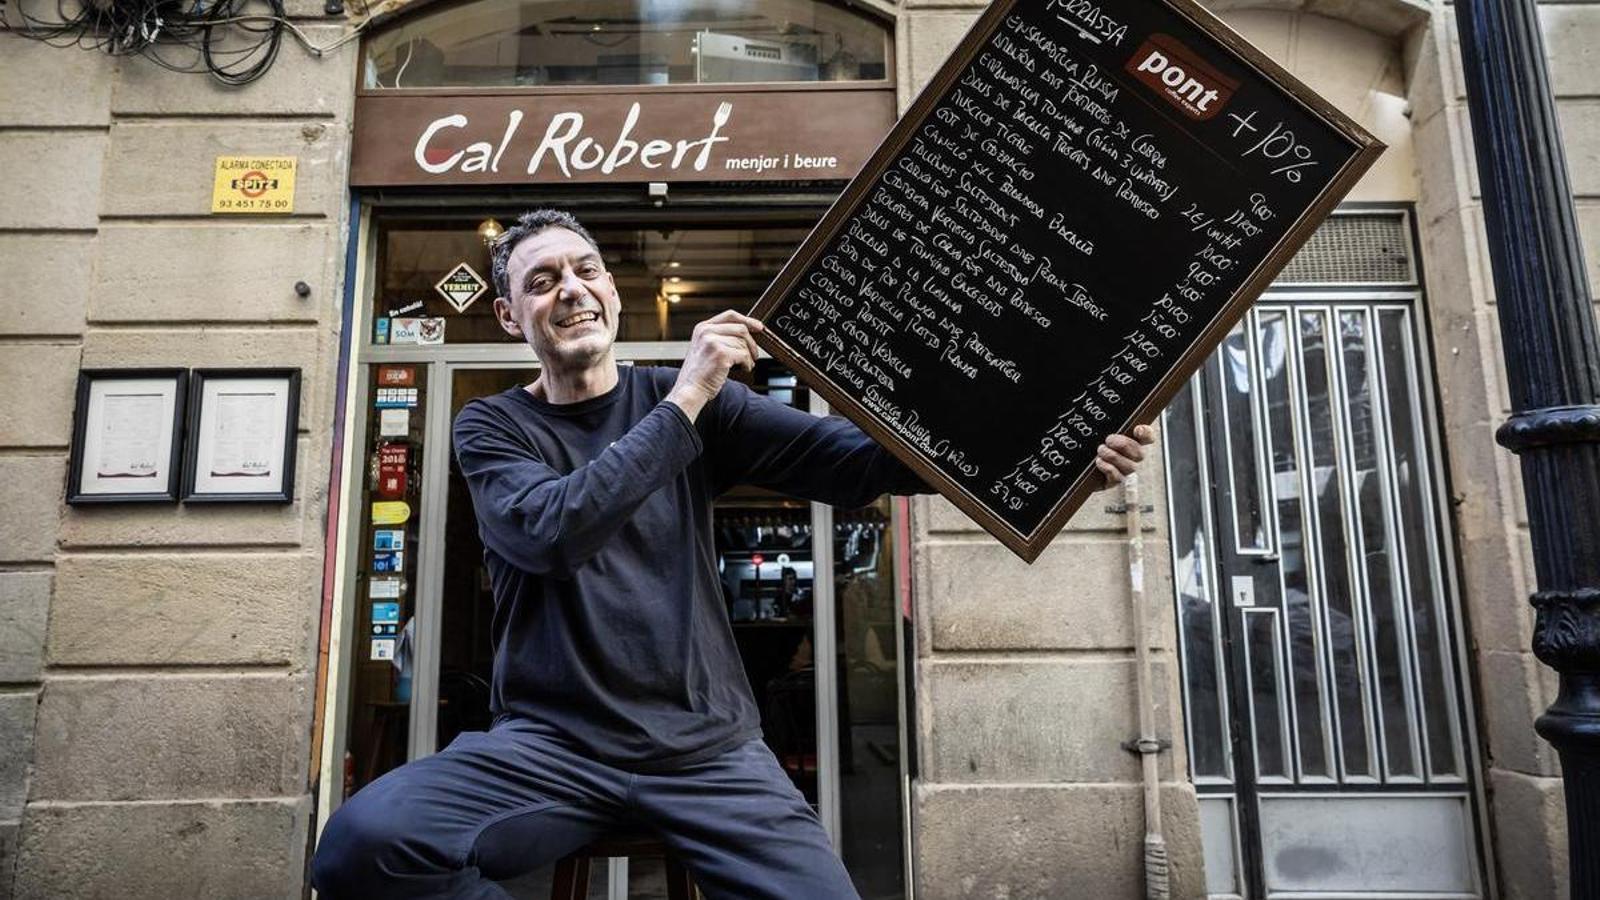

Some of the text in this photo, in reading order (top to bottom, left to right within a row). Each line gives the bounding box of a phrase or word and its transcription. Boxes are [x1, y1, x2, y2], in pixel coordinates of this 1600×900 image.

[1138, 51, 1218, 111] pont
[414, 102, 838, 177] Cal Robert menjar i beure
[1131, 134, 1166, 169] CABRA
[221, 160, 293, 170] ALARMA CONECTADA
[1119, 153, 1133, 168] 3
[235, 180, 275, 189] SPITZ
[219, 200, 289, 208] 93 451 75 00
[396, 330, 415, 338] SOM
[862, 396, 938, 458] www.cafespont.com
